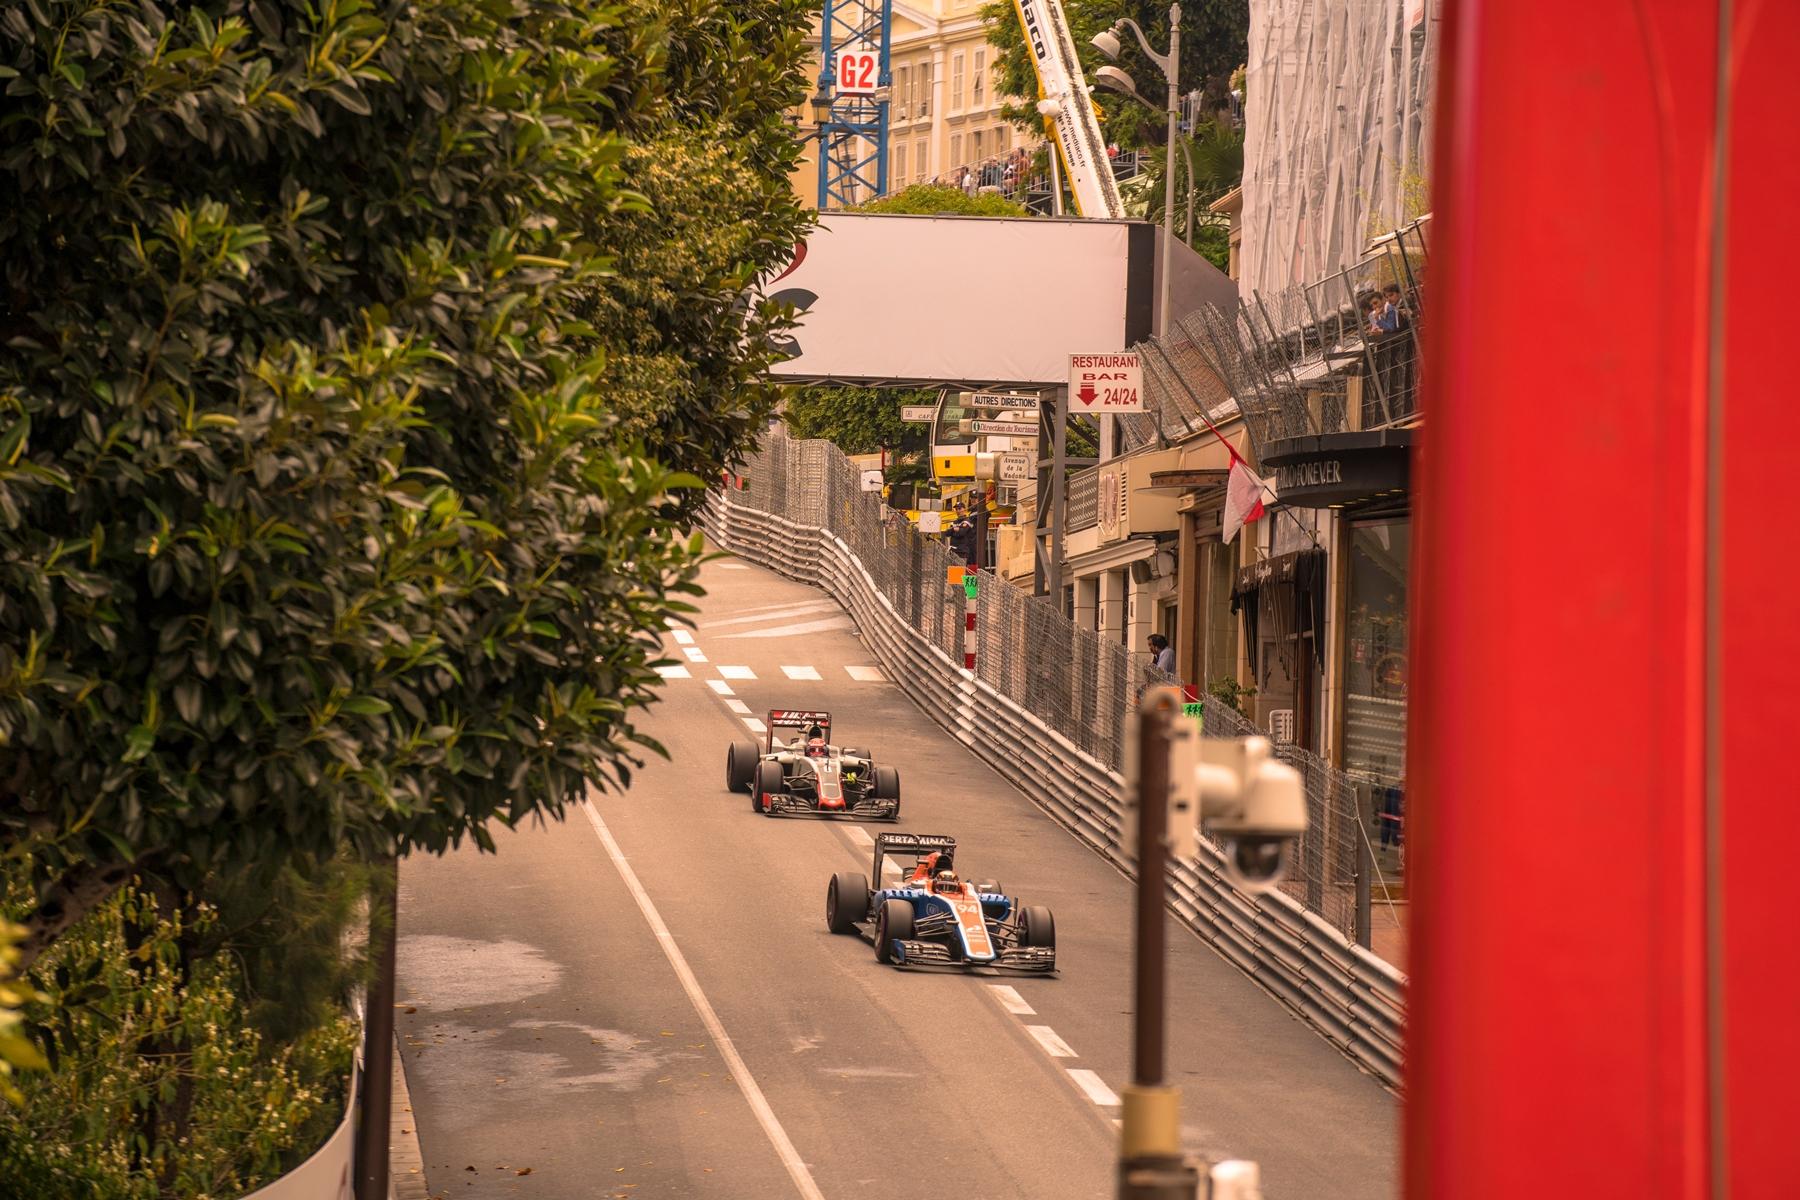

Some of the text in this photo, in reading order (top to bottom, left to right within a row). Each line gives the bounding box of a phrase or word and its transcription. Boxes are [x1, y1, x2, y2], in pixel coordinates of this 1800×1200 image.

[841, 55, 874, 88] G2
[1062, 105, 1086, 168] www.mediaco.fr
[1072, 356, 1140, 368] RESTAURANT
[1083, 373, 1128, 381] BAR
[974, 395, 1037, 408] AUTRES DIRECTIONS
[1104, 387, 1138, 405] 24/24
[980, 422, 1006, 432] Direction
[1005, 424, 1013, 433] du
[1297, 460, 1342, 487] FOREVER
[957, 904, 979, 913] 94
